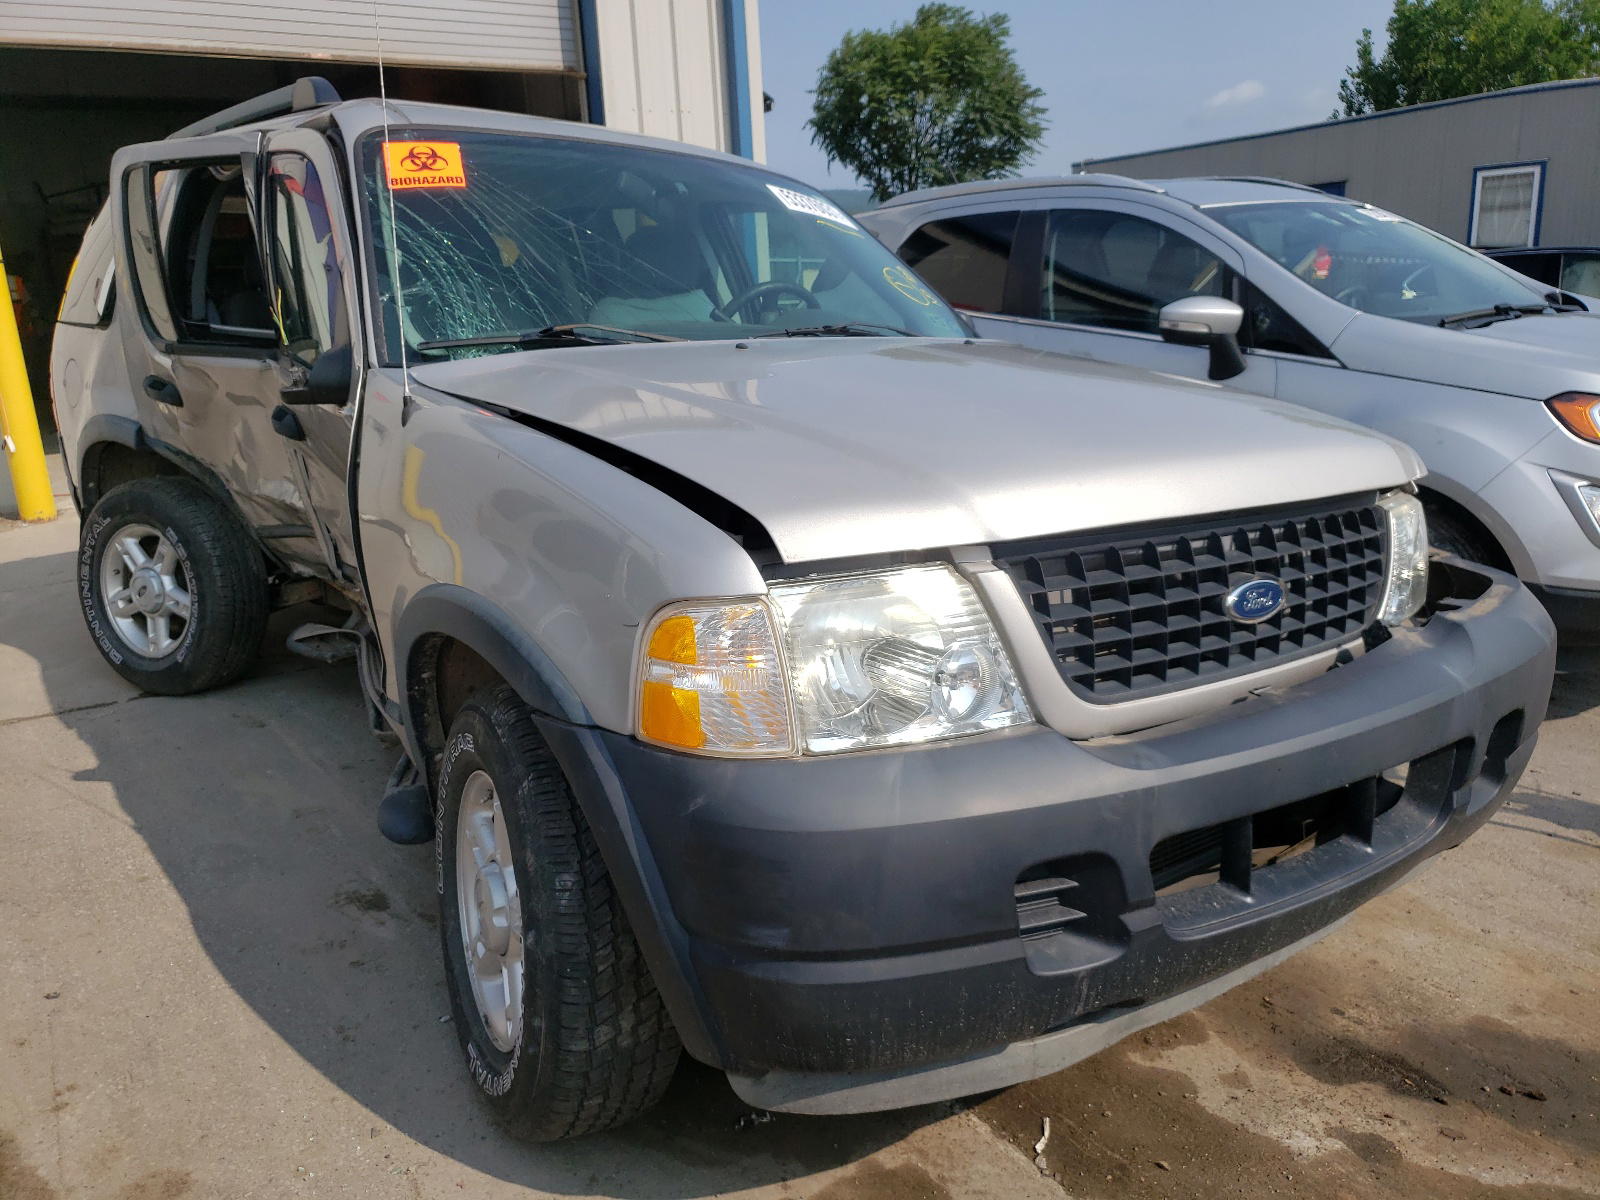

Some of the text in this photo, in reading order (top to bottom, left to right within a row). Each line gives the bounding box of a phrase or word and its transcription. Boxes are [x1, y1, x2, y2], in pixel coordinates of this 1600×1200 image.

[390, 176, 464, 186] BIOHAZARD
[80, 516, 123, 665] CONTINENTAL
[1243, 588, 1273, 612] Ford
[434, 732, 475, 894] CONTITRAC
